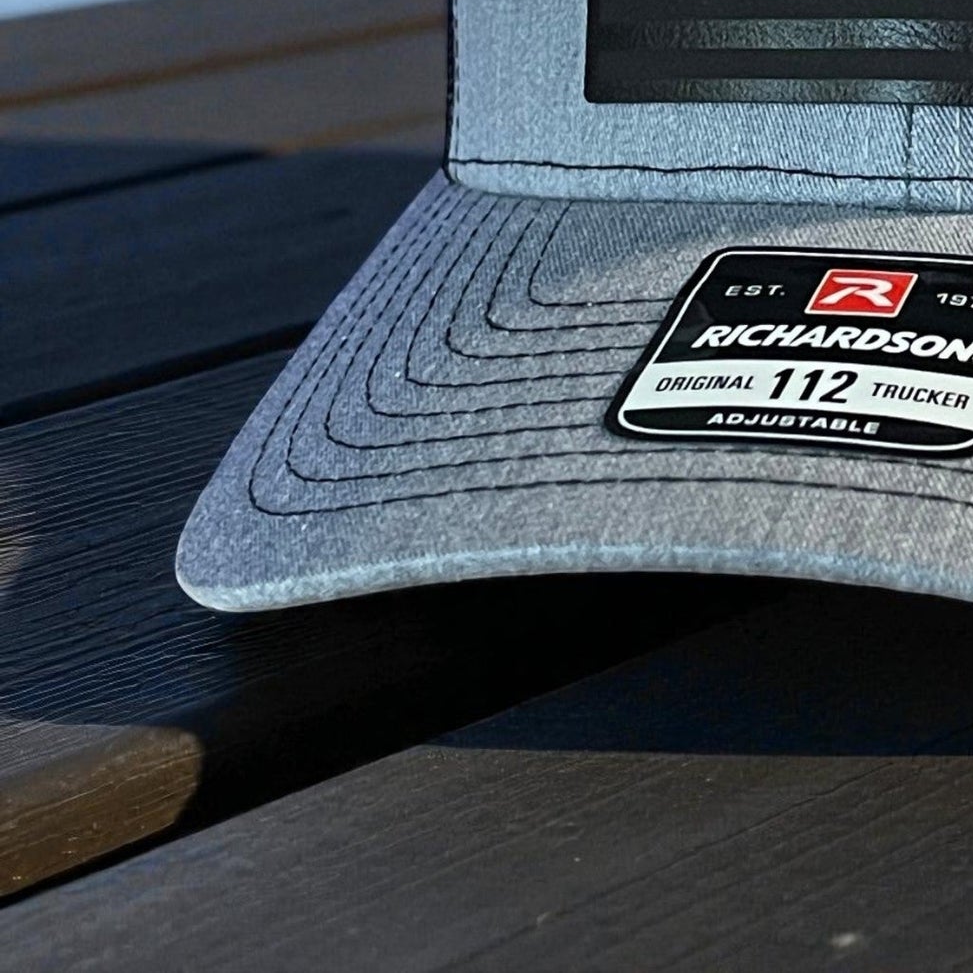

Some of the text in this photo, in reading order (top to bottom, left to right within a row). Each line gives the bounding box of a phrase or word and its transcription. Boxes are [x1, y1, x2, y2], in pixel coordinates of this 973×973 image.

[725, 283, 786, 298] EST.
[655, 367, 970, 411] ORIGINAL 112 TRUCKER
[706, 411, 881, 436] ADJUSTABLE
